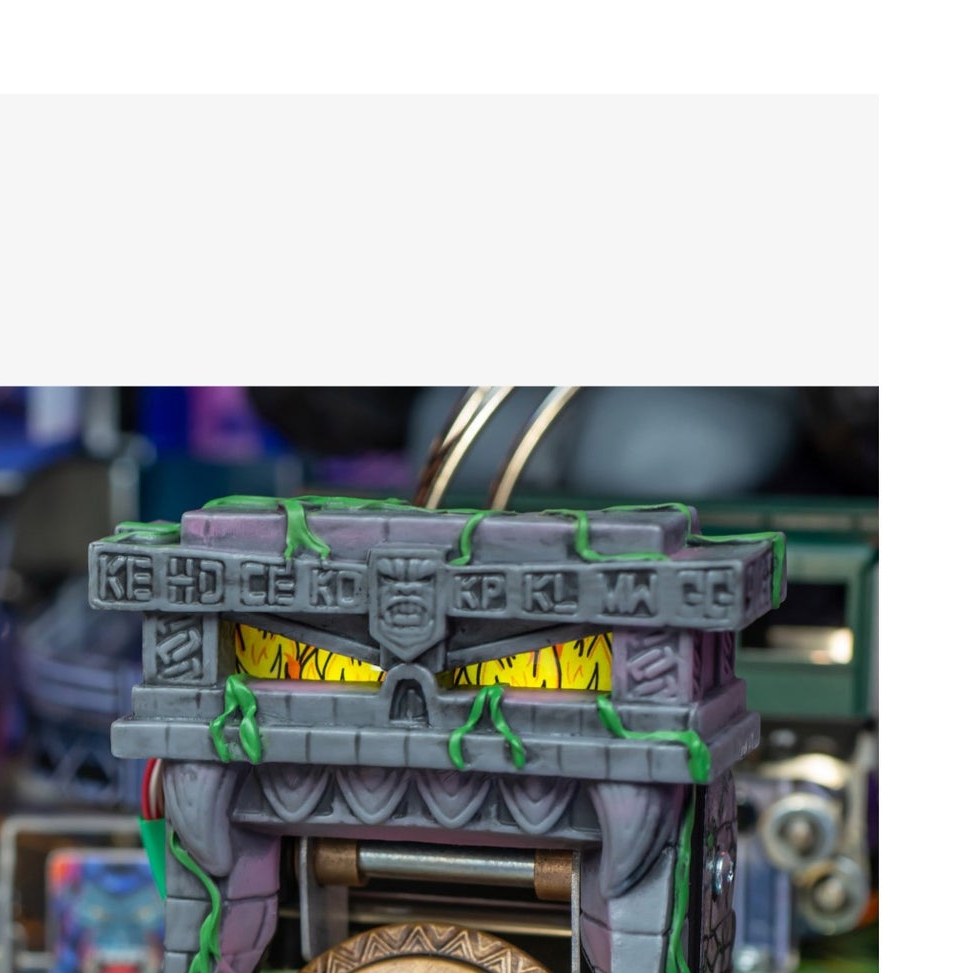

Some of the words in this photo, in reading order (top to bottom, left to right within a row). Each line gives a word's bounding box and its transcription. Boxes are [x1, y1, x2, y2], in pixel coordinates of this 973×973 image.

[97, 554, 153, 600] KE
[166, 557, 226, 605] HD
[240, 562, 296, 606] CE
[454, 573, 505, 610] KP
[525, 573, 577, 612] KL
